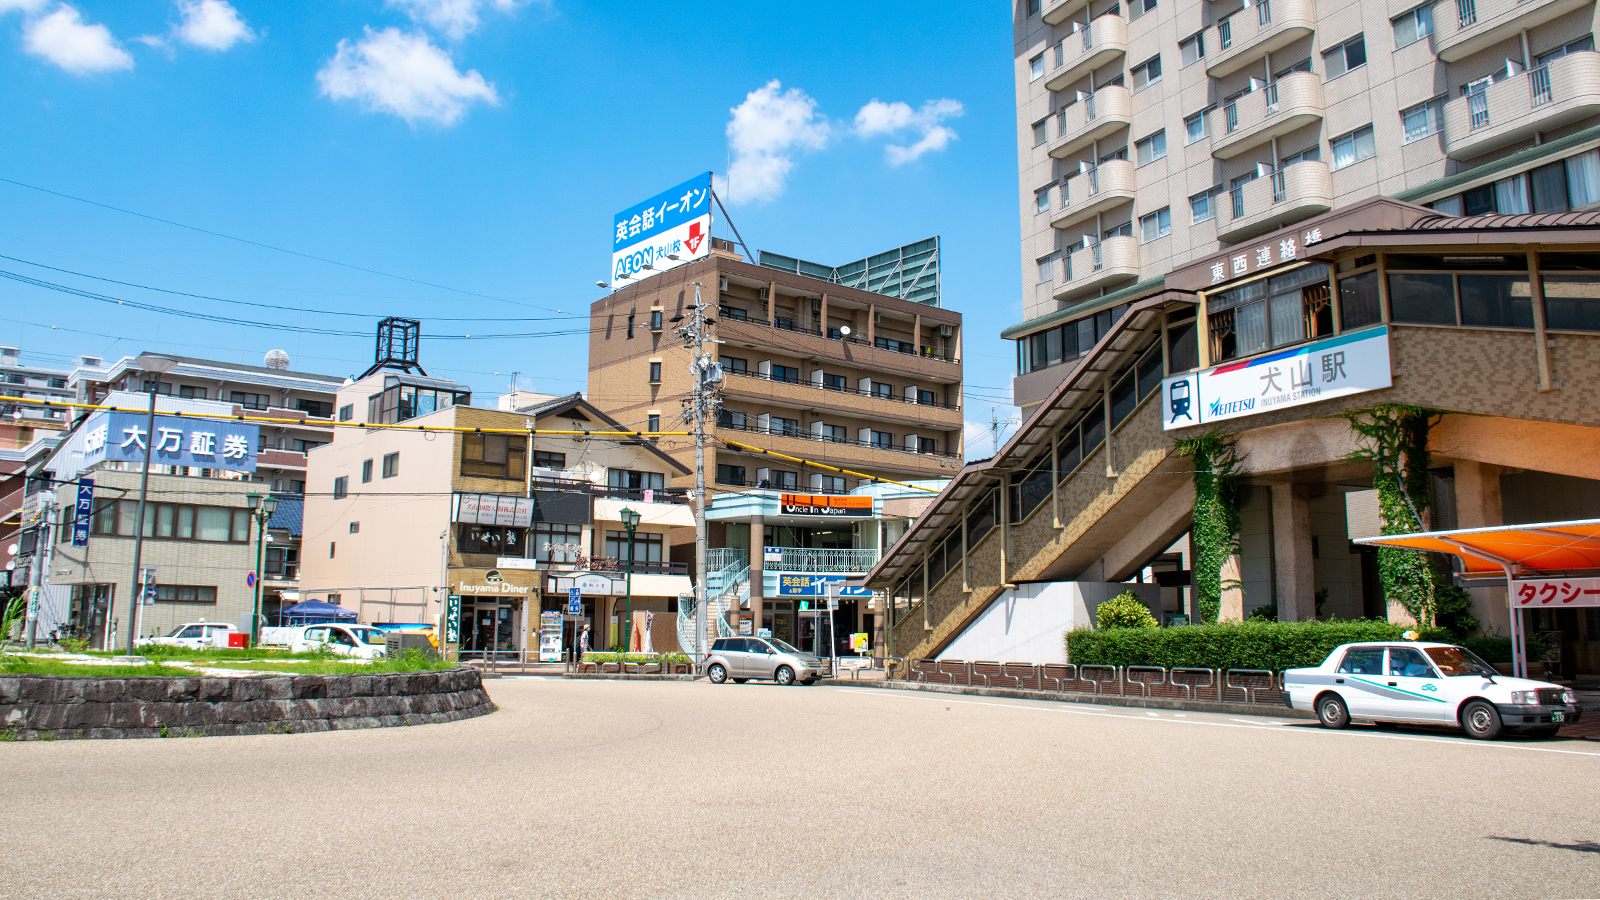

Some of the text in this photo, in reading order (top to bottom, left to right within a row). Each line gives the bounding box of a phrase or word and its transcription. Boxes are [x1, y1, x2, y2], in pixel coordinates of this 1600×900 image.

[615, 188, 706, 243] 英会話イーオン
[689, 236, 700, 250] 1F
[1210, 228, 1323, 282] 東西連絡橋
[615, 239, 681, 281] AEON 犬山校
[1259, 351, 1347, 396] 犬山駅
[1208, 396, 1255, 418] MEITETSU
[1260, 387, 1321, 407] INUYAMA STATION
[120, 424, 248, 458] 大万証券
[75, 484, 92, 541] 大万証券
[460, 581, 529, 594] Inuyama Diner
[782, 576, 810, 587] 英会話
[1518, 582, 1600, 605] タクシー
